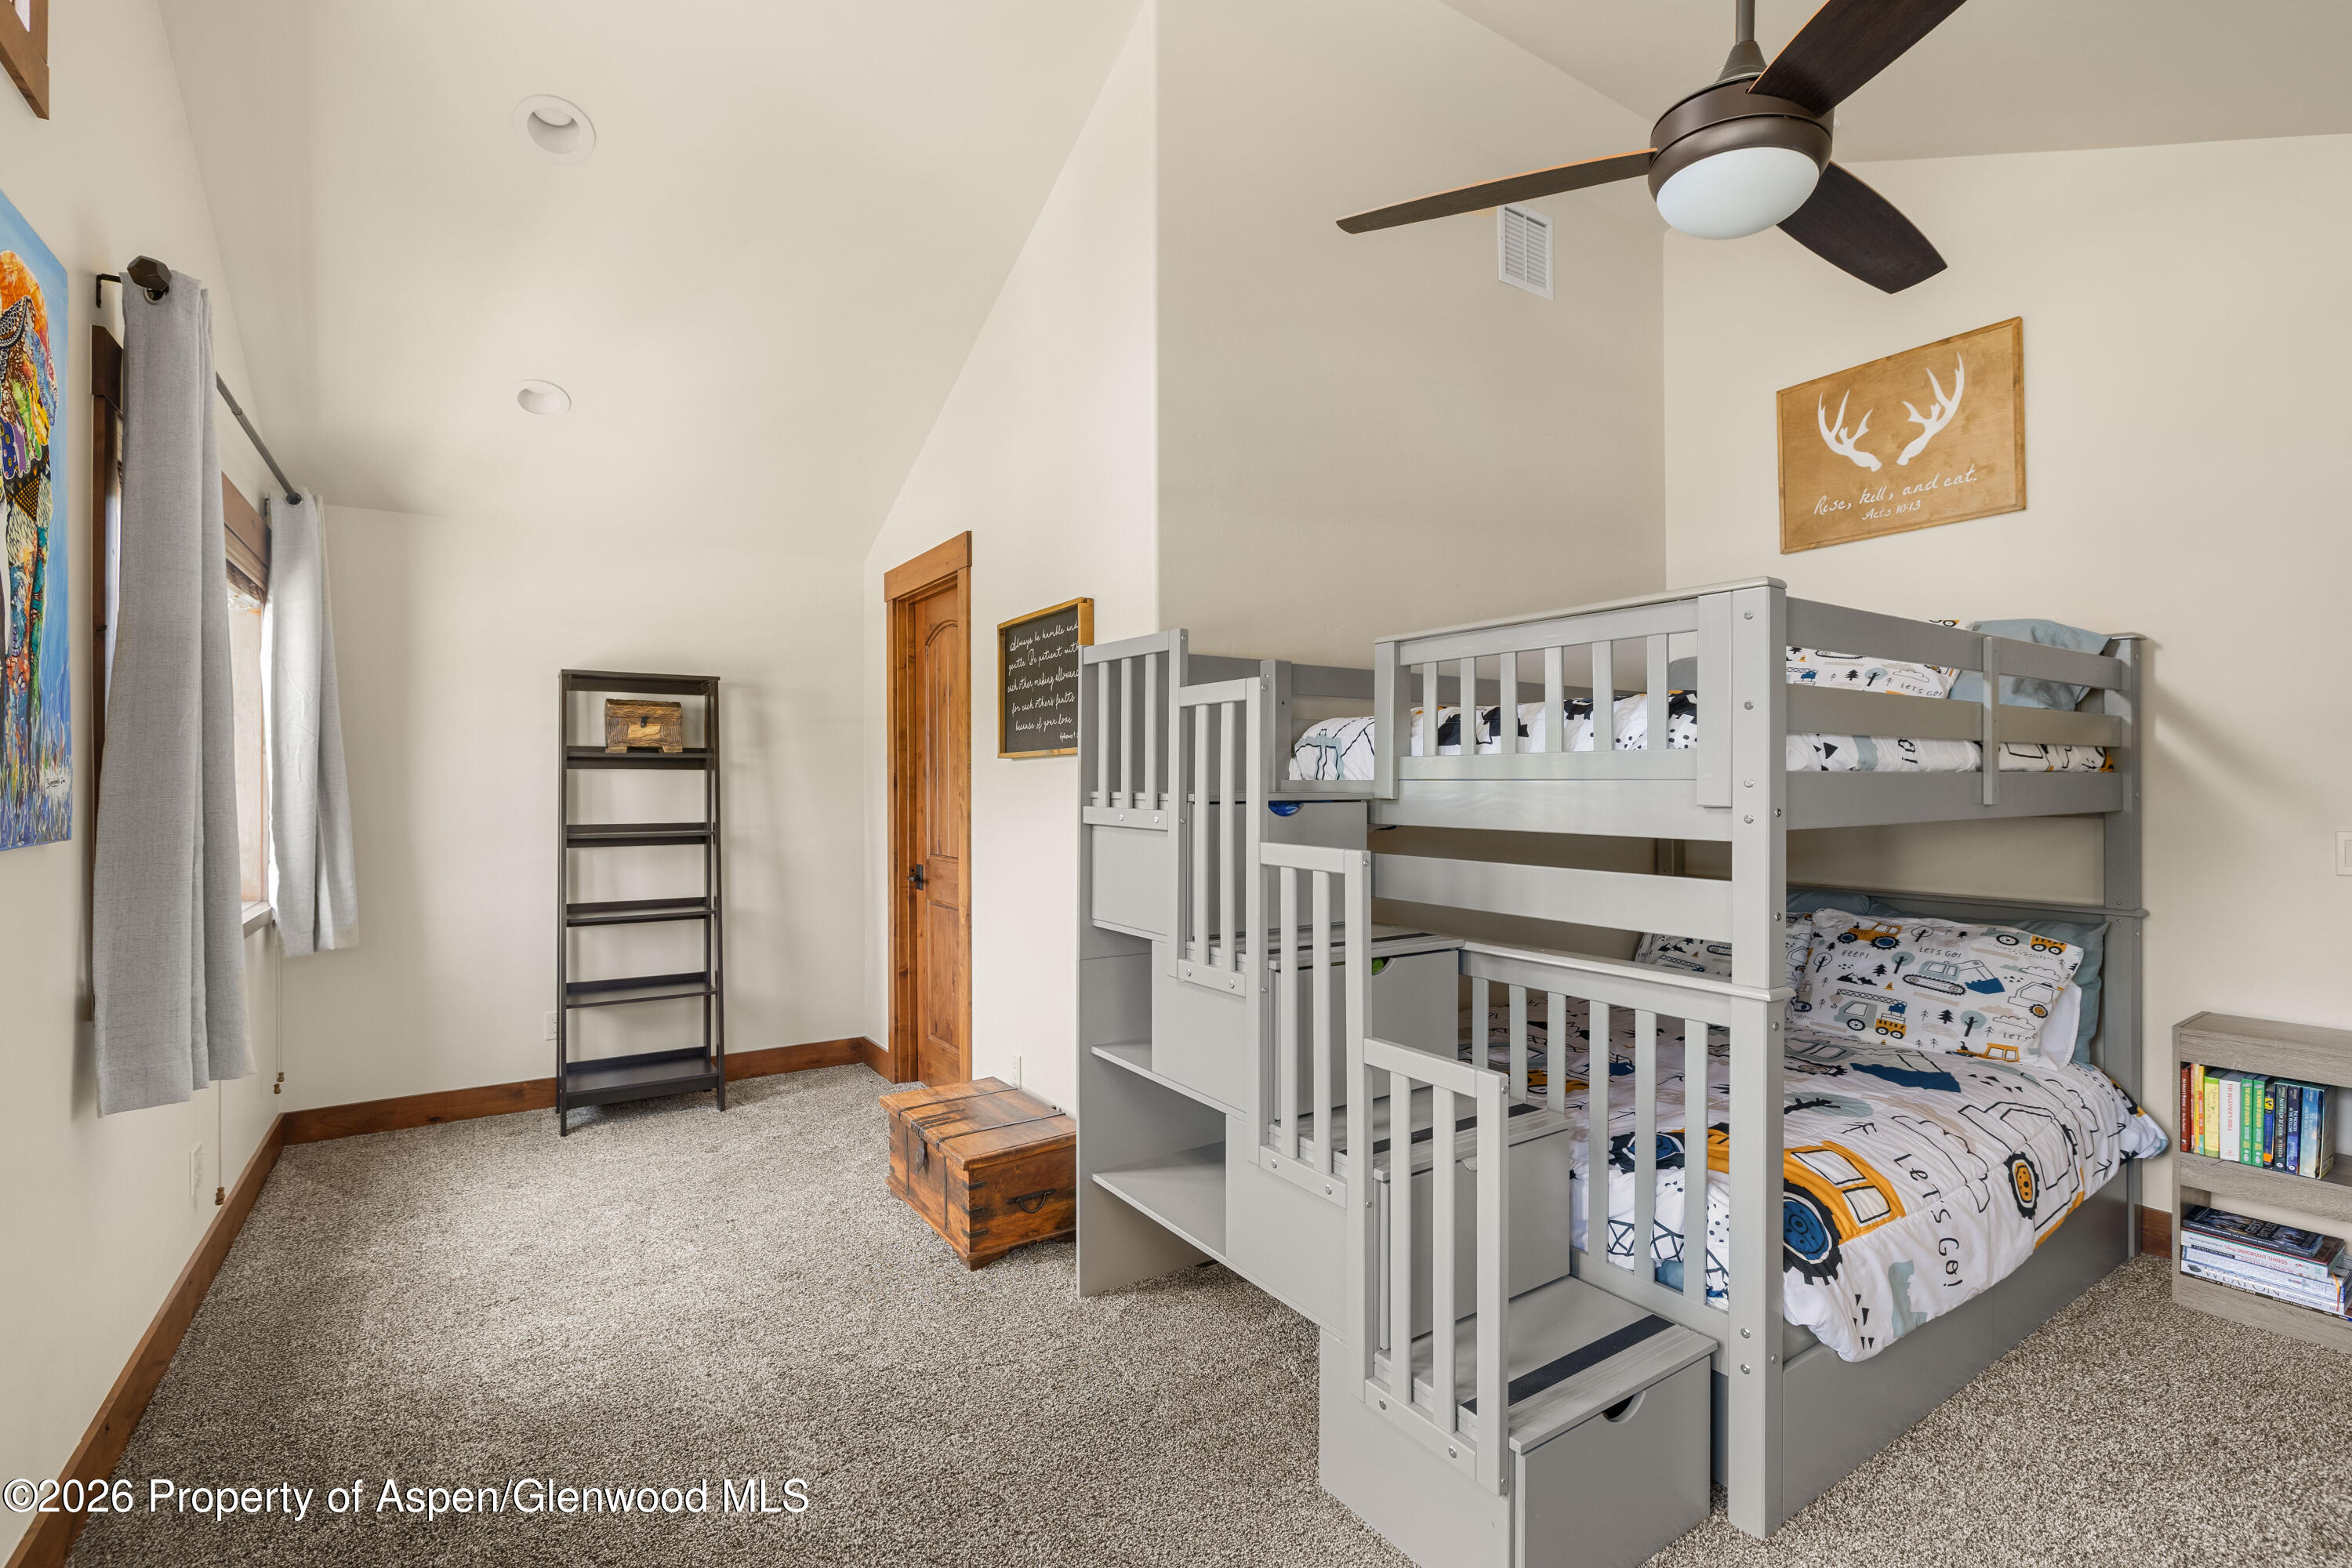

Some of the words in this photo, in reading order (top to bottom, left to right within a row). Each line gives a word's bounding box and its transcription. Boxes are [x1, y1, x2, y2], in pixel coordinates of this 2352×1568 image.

[1813, 495, 1853, 515] Rise,
[1859, 487, 1893, 504] kill,
[1902, 472, 1940, 495] and
[1944, 463, 1977, 487] eat.
[1862, 508, 1892, 520] Acts
[1896, 499, 1922, 514] 10:13
[1009, 635, 1033, 652] Always
[1035, 631, 1040, 642] be
[1043, 624, 1065, 640] humble
[1067, 619, 1078, 632] and
[1008, 657, 1026, 676] gentle.
[1028, 649, 1037, 666] Be
[1039, 647, 1062, 666] patient
[1007, 681, 1018, 692] each
[1018, 677, 1033, 692] other,
[1034, 671, 1054, 691] making
[1055, 666, 1079, 681] allowanc
[1022, 701, 1033, 710] each
[1035, 696, 1054, 709] other's
[1055, 691, 1076, 710] faults
[1016, 720, 1035, 731] because
[1036, 717, 1043, 733] of
[1044, 717, 1057, 732] your
[1058, 713, 1073, 725] love.
[2238, 1249, 2267, 1259] IMPORTANT
[2268, 1256, 2288, 1265] THINGS
